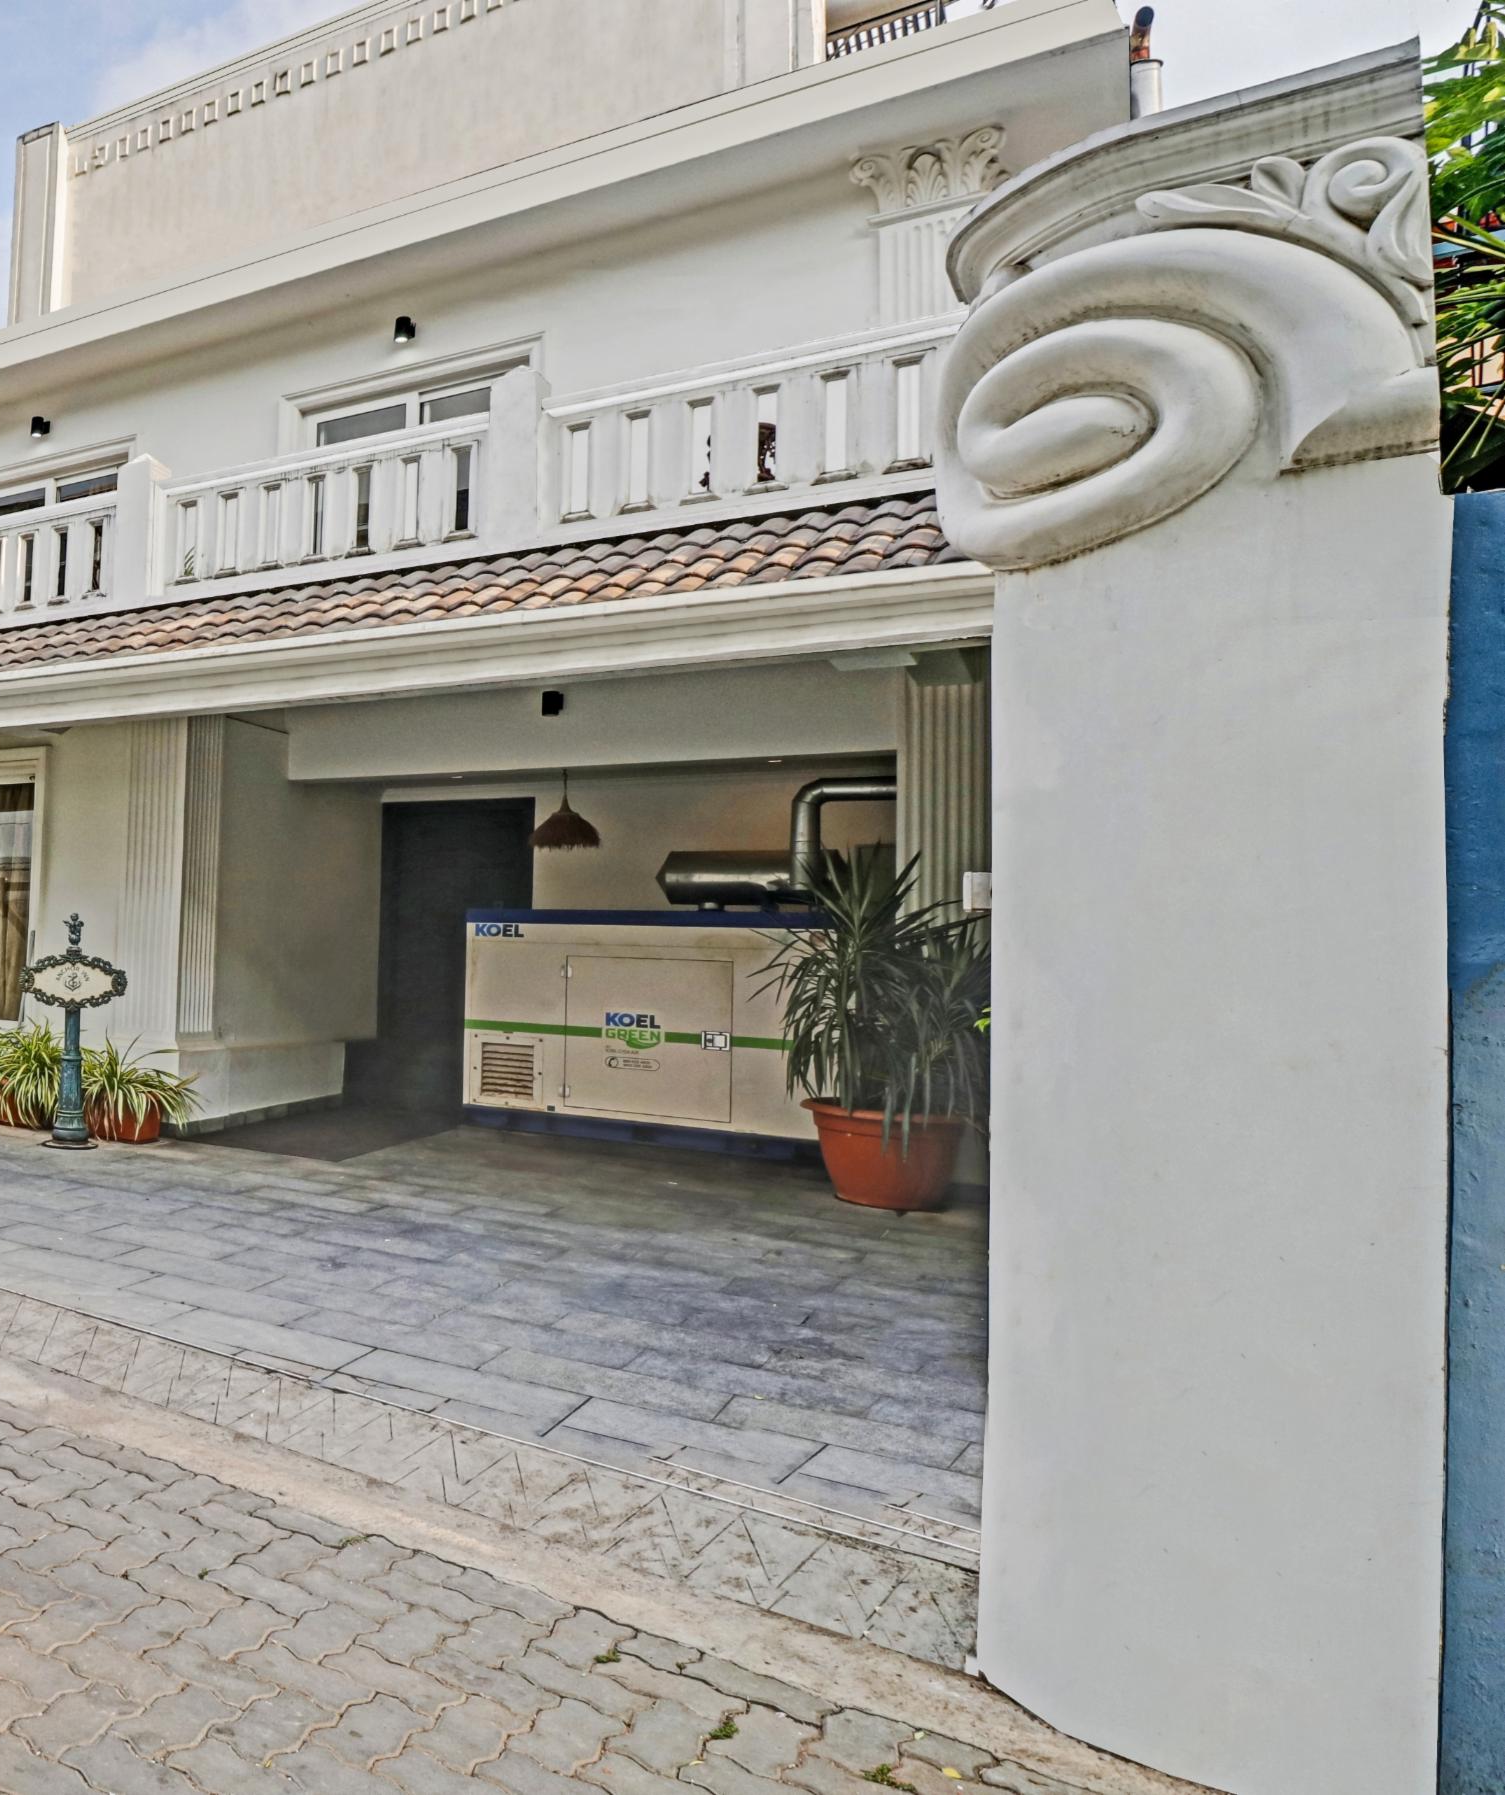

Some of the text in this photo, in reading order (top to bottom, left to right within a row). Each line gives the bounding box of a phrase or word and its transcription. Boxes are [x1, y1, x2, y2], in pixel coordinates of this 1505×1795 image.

[475, 924, 524, 938] KOEL
[605, 1012, 661, 1030] KOEL
[605, 1027, 661, 1043] GREEN
